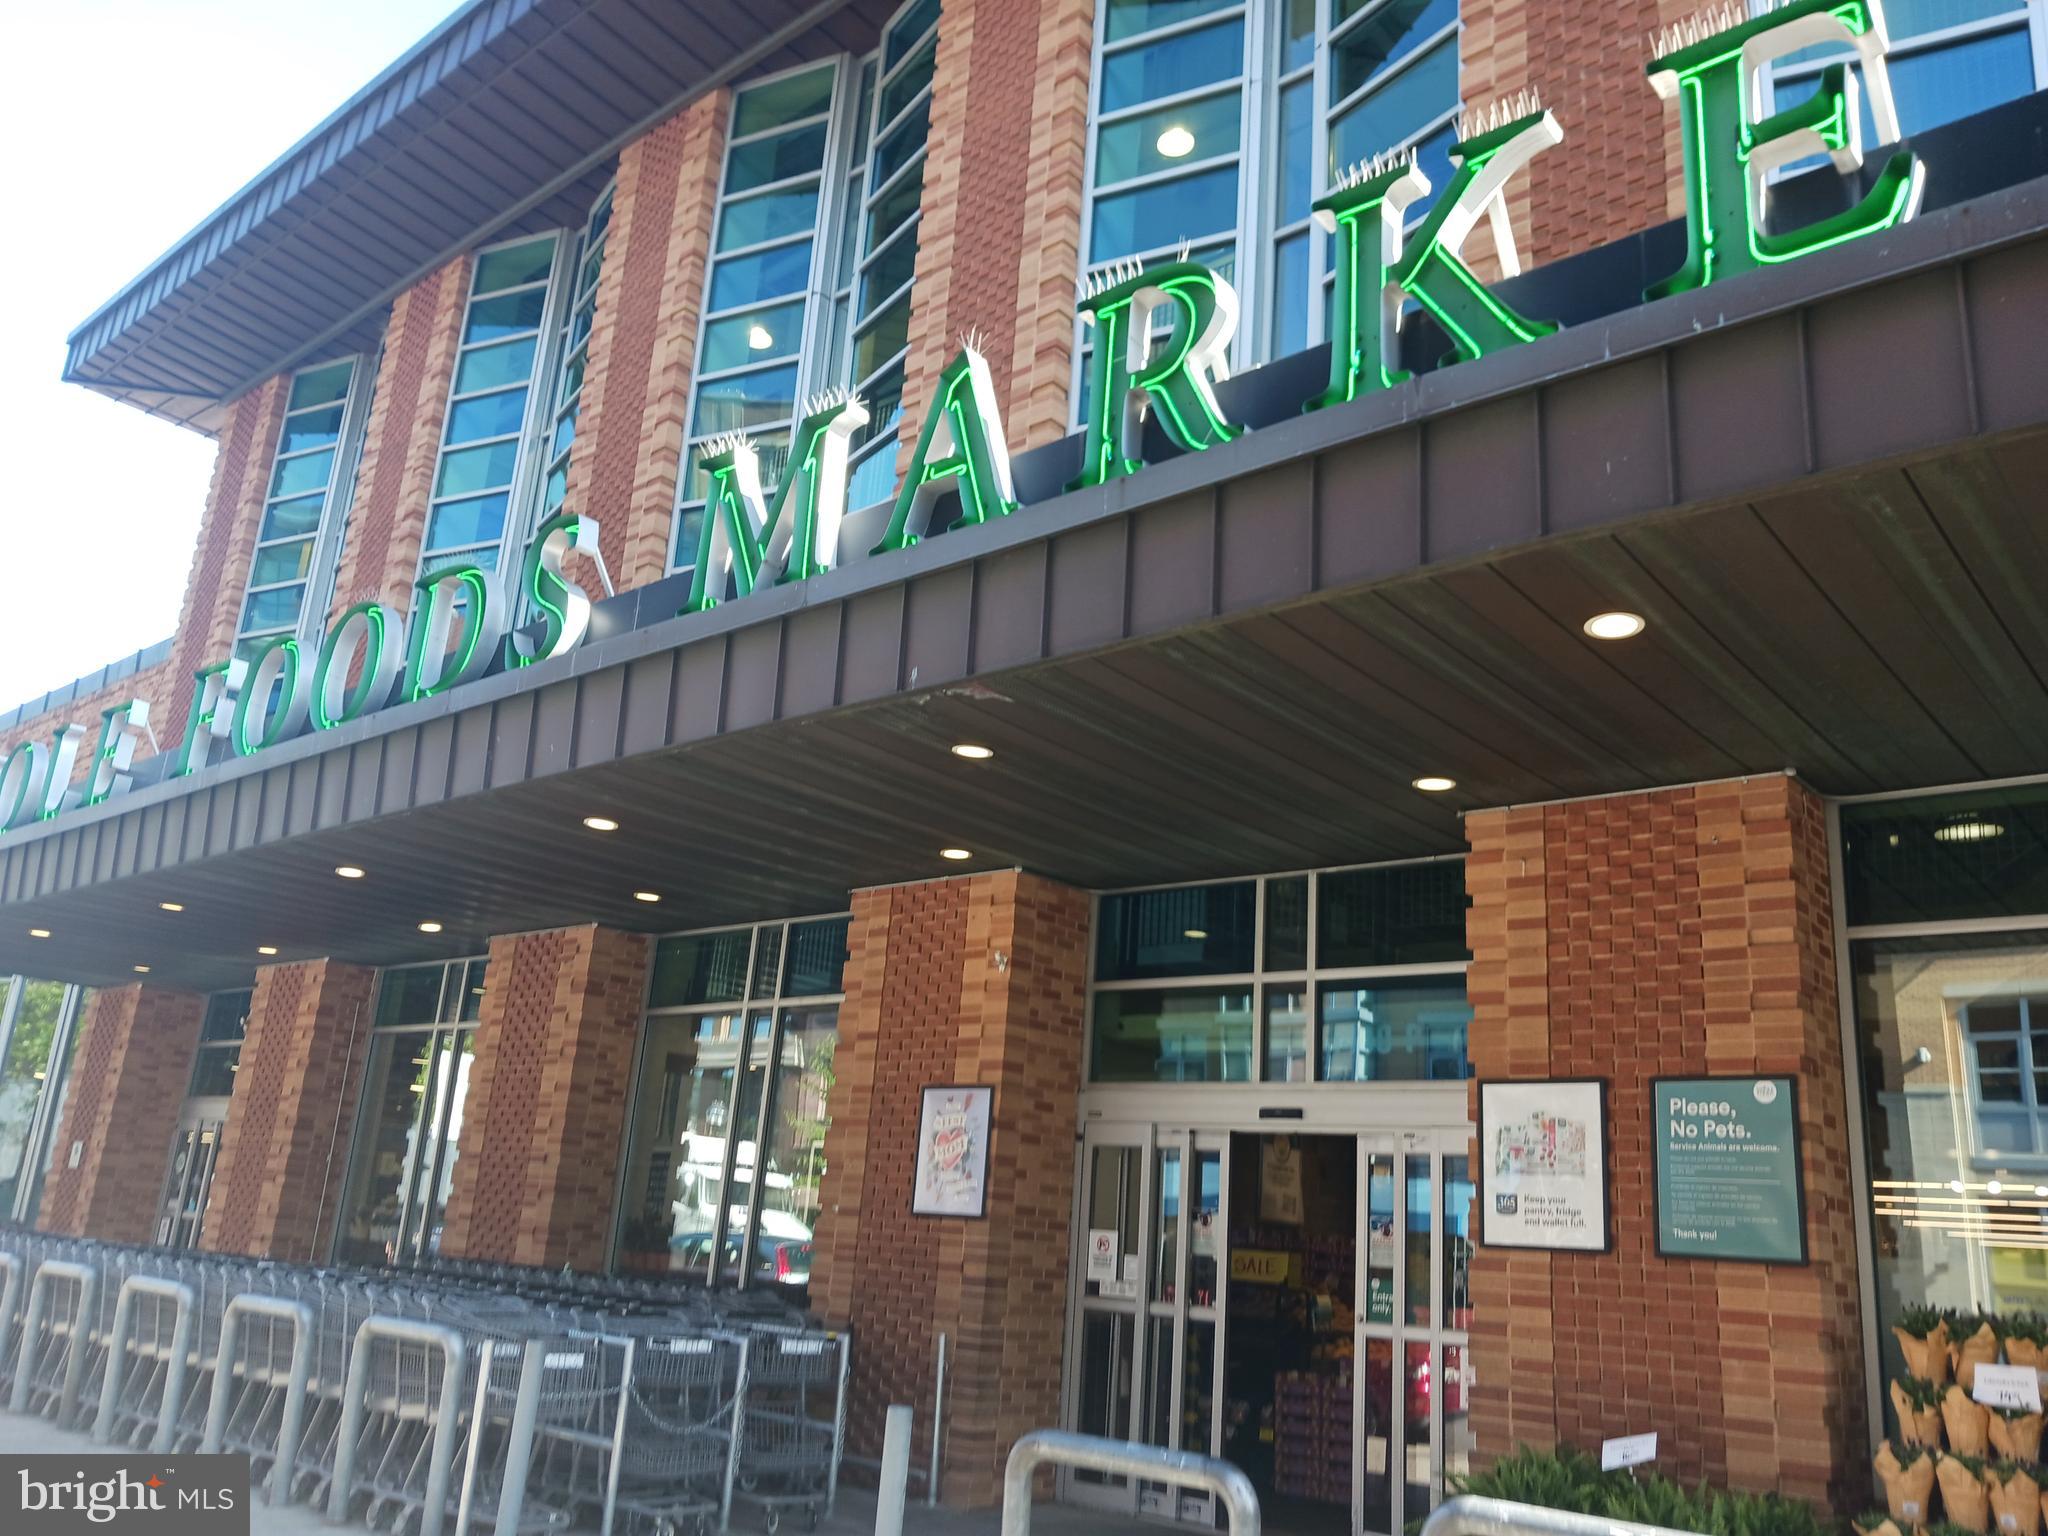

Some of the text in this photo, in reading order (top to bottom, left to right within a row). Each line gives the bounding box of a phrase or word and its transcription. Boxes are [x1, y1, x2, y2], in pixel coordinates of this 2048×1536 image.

[0, 0, 1924, 834] OLE FOODS MARKE
[1669, 1097, 1737, 1119] Please,
[1670, 1119, 1752, 1139] No Pets.
[1669, 1141, 1697, 1151] Service
[1698, 1142, 1727, 1151] Animals
[1742, 1143, 1781, 1153] welcome.
[1524, 1194, 1566, 1206] Keep your
[1524, 1206, 1582, 1217] pantry, fridge
[1524, 1217, 1587, 1229] and wallet full.
[1673, 1227, 1718, 1242] Thank you!
[1234, 1255, 1277, 1277] SALE
